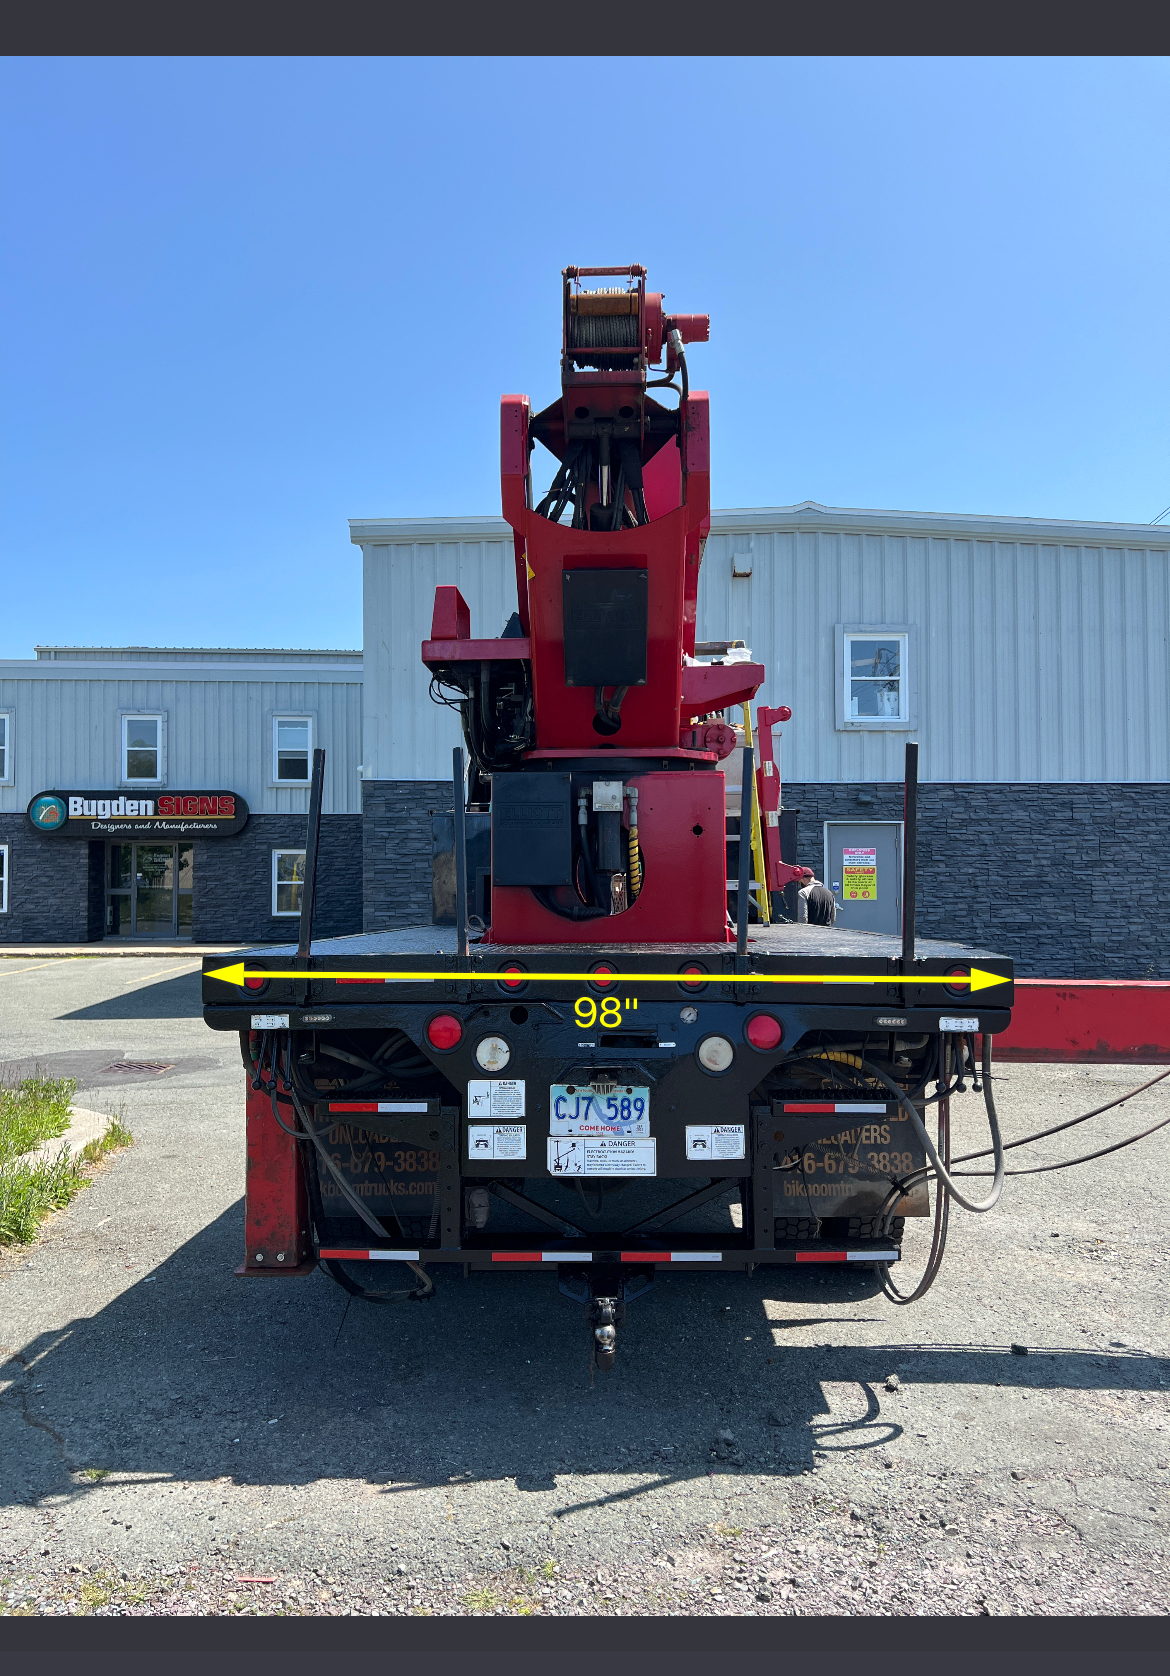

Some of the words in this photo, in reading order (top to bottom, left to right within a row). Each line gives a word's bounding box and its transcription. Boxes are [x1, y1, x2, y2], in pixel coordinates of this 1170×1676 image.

[68, 796, 154, 820] Bugden
[158, 796, 235, 816] SIGNS
[501, 807, 562, 820] ELLIOTT
[91, 821, 132, 832] Designers
[134, 821, 151, 830] and
[153, 821, 218, 832] Manufacturers
[554, 1095, 593, 1121] CJ7
[606, 1096, 645, 1121] 589
[329, 1123, 403, 1145] UNLOA
[579, 1124, 599, 1132] COME
[816, 1124, 891, 1145] ADERS
[319, 1150, 439, 1175] 16-679-3838
[781, 1151, 914, 1175] 416-6793838
[320, 1178, 437, 1197] kbomtrucks.com
